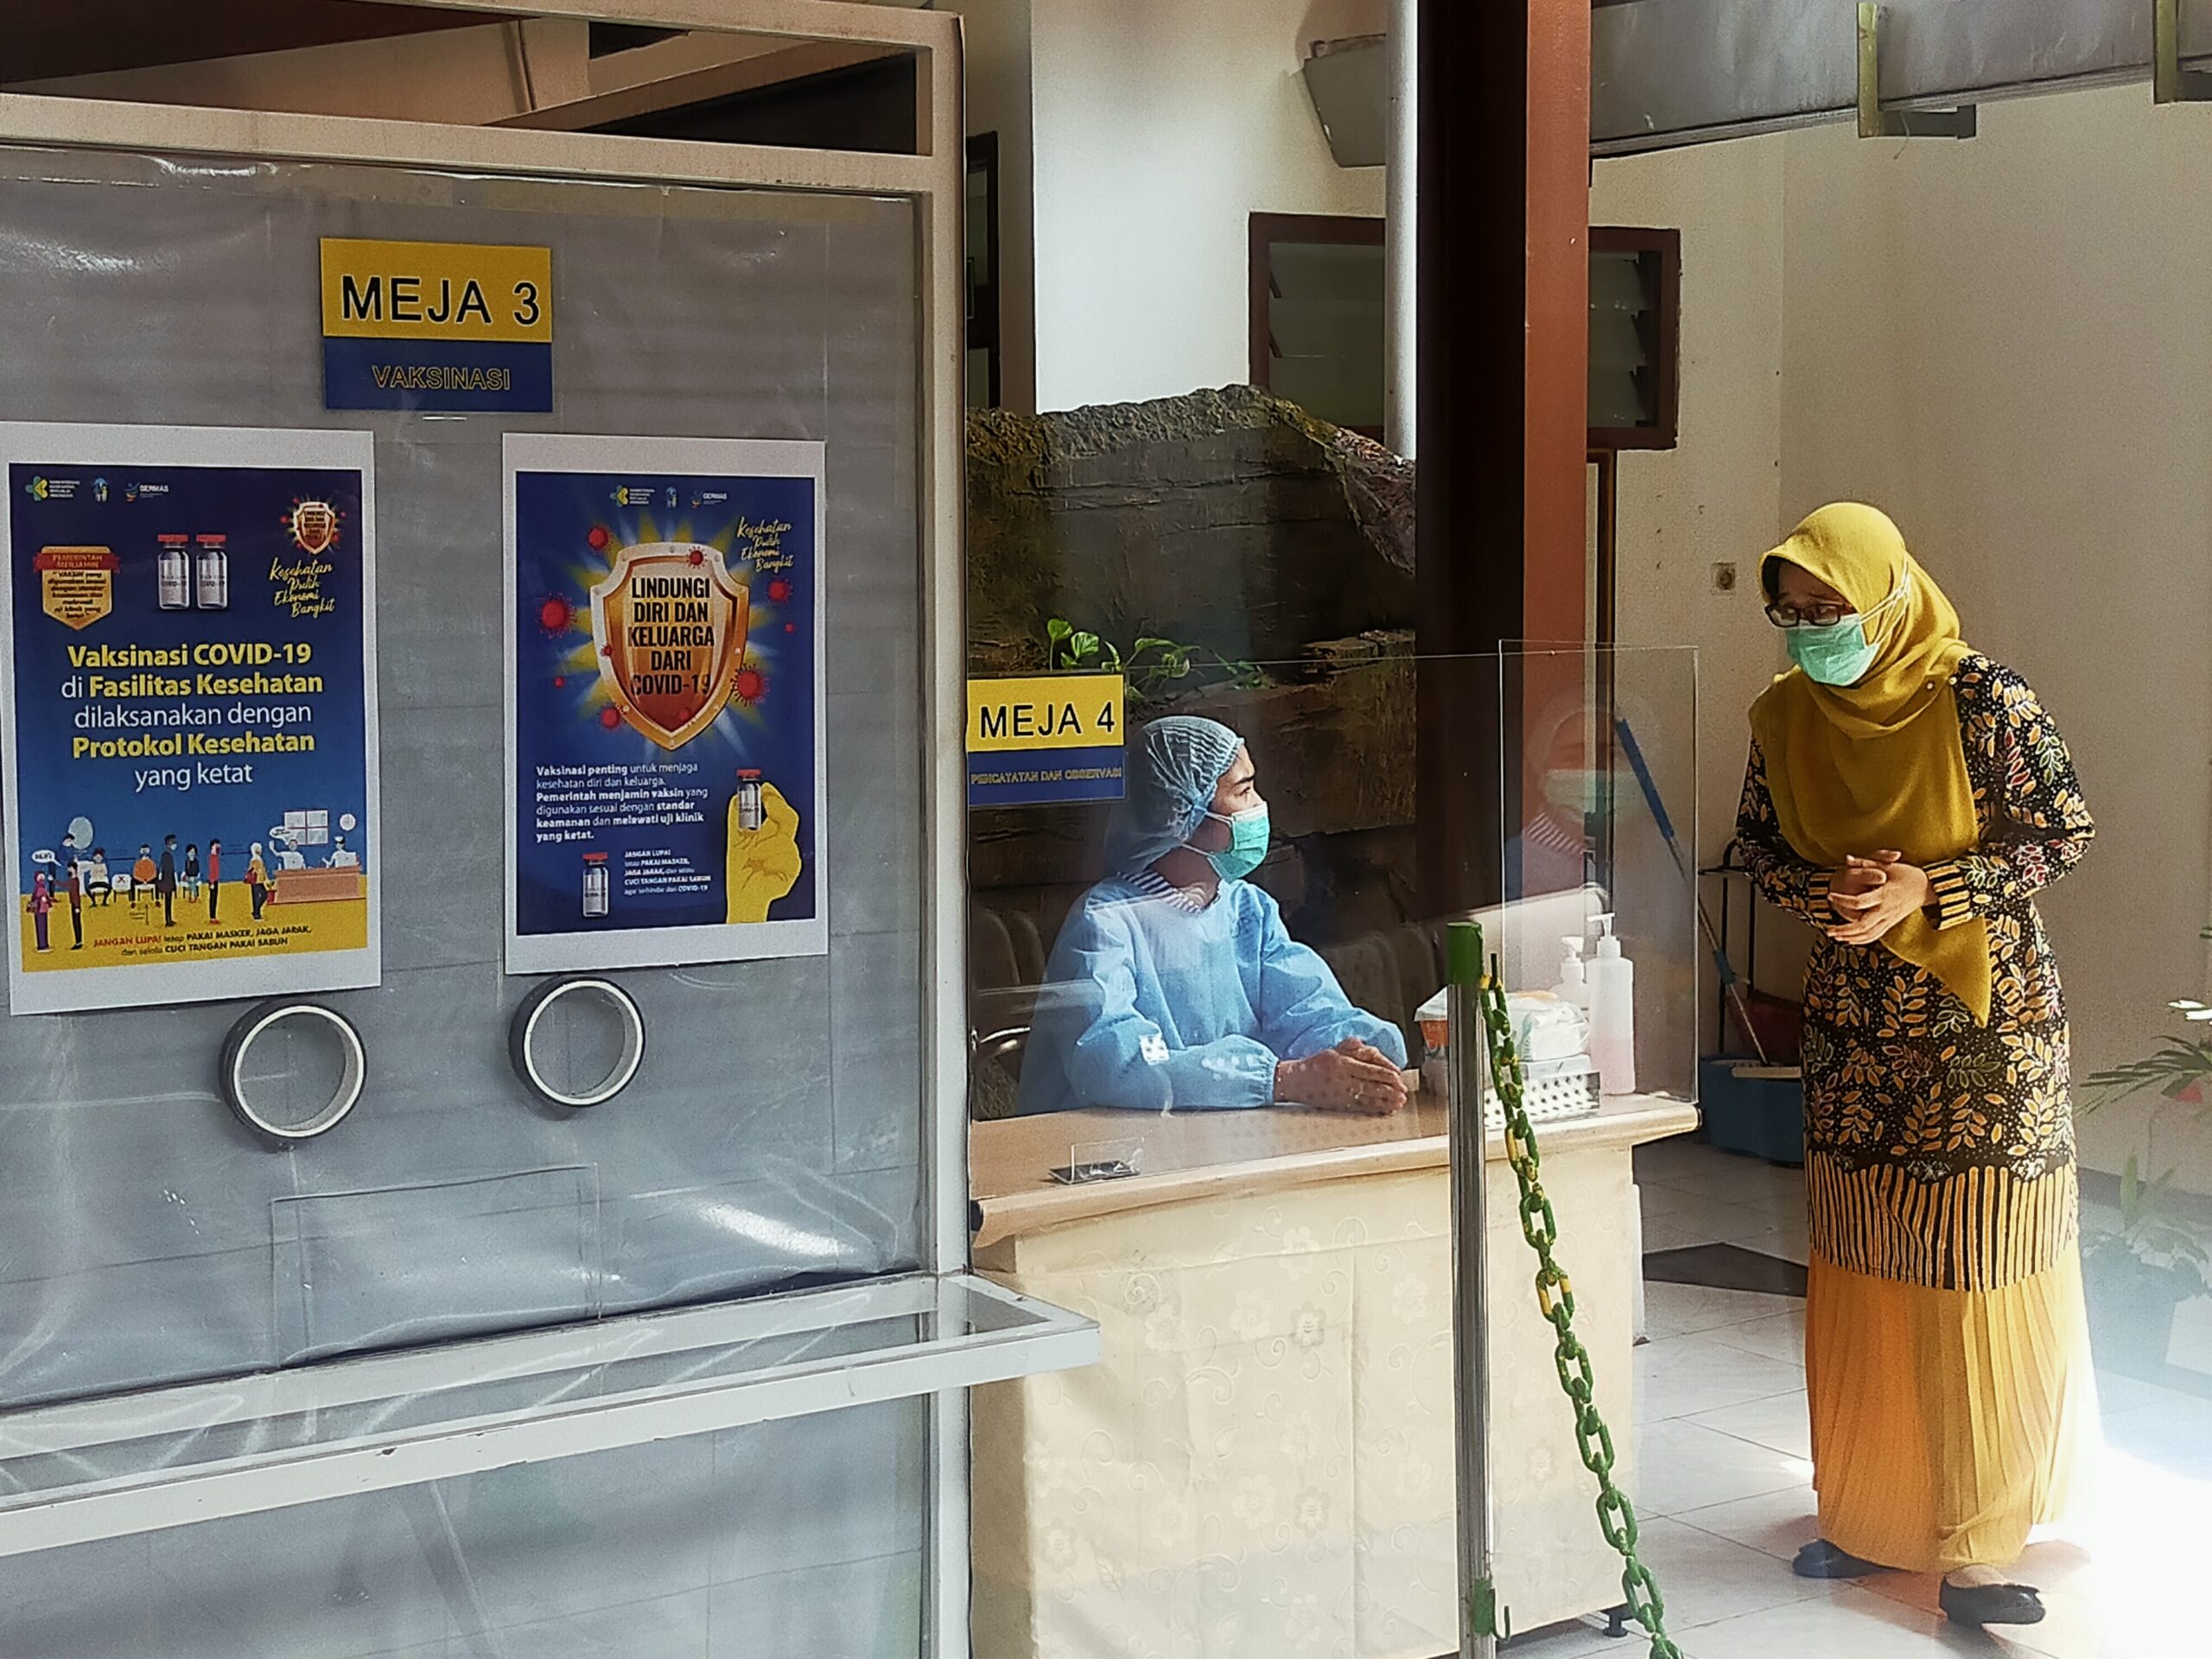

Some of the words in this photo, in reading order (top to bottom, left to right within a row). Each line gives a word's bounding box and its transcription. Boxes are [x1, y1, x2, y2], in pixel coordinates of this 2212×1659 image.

[341, 275, 492, 324] MEJA
[512, 281, 541, 327] 3
[372, 365, 511, 390] VAKSINASI
[737, 516, 791, 538] Kesehatan
[270, 557, 333, 581] Kesehatan
[755, 554, 794, 574] Bangkit
[632, 577, 710, 599] LINDUNGI
[291, 598, 335, 619] Bangkit
[633, 601, 669, 623] DIRI
[675, 601, 709, 623] DAN
[627, 625, 715, 647] KELUARGA
[67, 644, 188, 667] Vaksinasi
[194, 643, 312, 666] COVID-19
[651, 650, 691, 671] DARI
[61, 675, 83, 698] di
[89, 673, 192, 697] Fasilitas
[196, 672, 323, 695] Kesehatan
[632, 674, 711, 696] COVID-19
[74, 702, 222, 728] dilaksanakan
[227, 702, 312, 728] dengan
[980, 702, 1082, 739] MEJA
[1096, 701, 1116, 733] 4
[73, 733, 181, 759] Protokol
[188, 731, 315, 755] Kesehatan
[135, 767, 191, 792] yang
[198, 762, 253, 784] ketat
[537, 765, 586, 777] Vaksinasi
[588, 764, 628, 778] penting
[630, 763, 657, 773] untuk
[658, 762, 698, 774] menjaga
[537, 778, 585, 790] kesehatan
[587, 777, 602, 788] diri
[604, 777, 622, 788] dan
[624, 776, 666, 788] keluarga.
[537, 790, 596, 802] Pemerintah
[598, 788, 650, 802] menjamin
[652, 787, 684, 798] vaksin
[685, 788, 709, 799] yang
[537, 804, 588, 817] digunakan
[588, 803, 618, 814] sesuai
[620, 802, 656, 815] dengan
[657, 800, 696, 811] standar
[537, 817, 591, 829] keamanan
[593, 816, 611, 827] dan
[613, 814, 659, 825] melewati
[660, 813, 674, 825] uji
[676, 812, 704, 823] klinik
[537, 832, 563, 843] yang
[564, 830, 594, 841] ketat.
[678, 884, 709, 893] COVID-19
[94, 936, 133, 947] JANGAN
[188, 942, 227, 951] TANGAN
[230, 939, 256, 949] PAKAI
